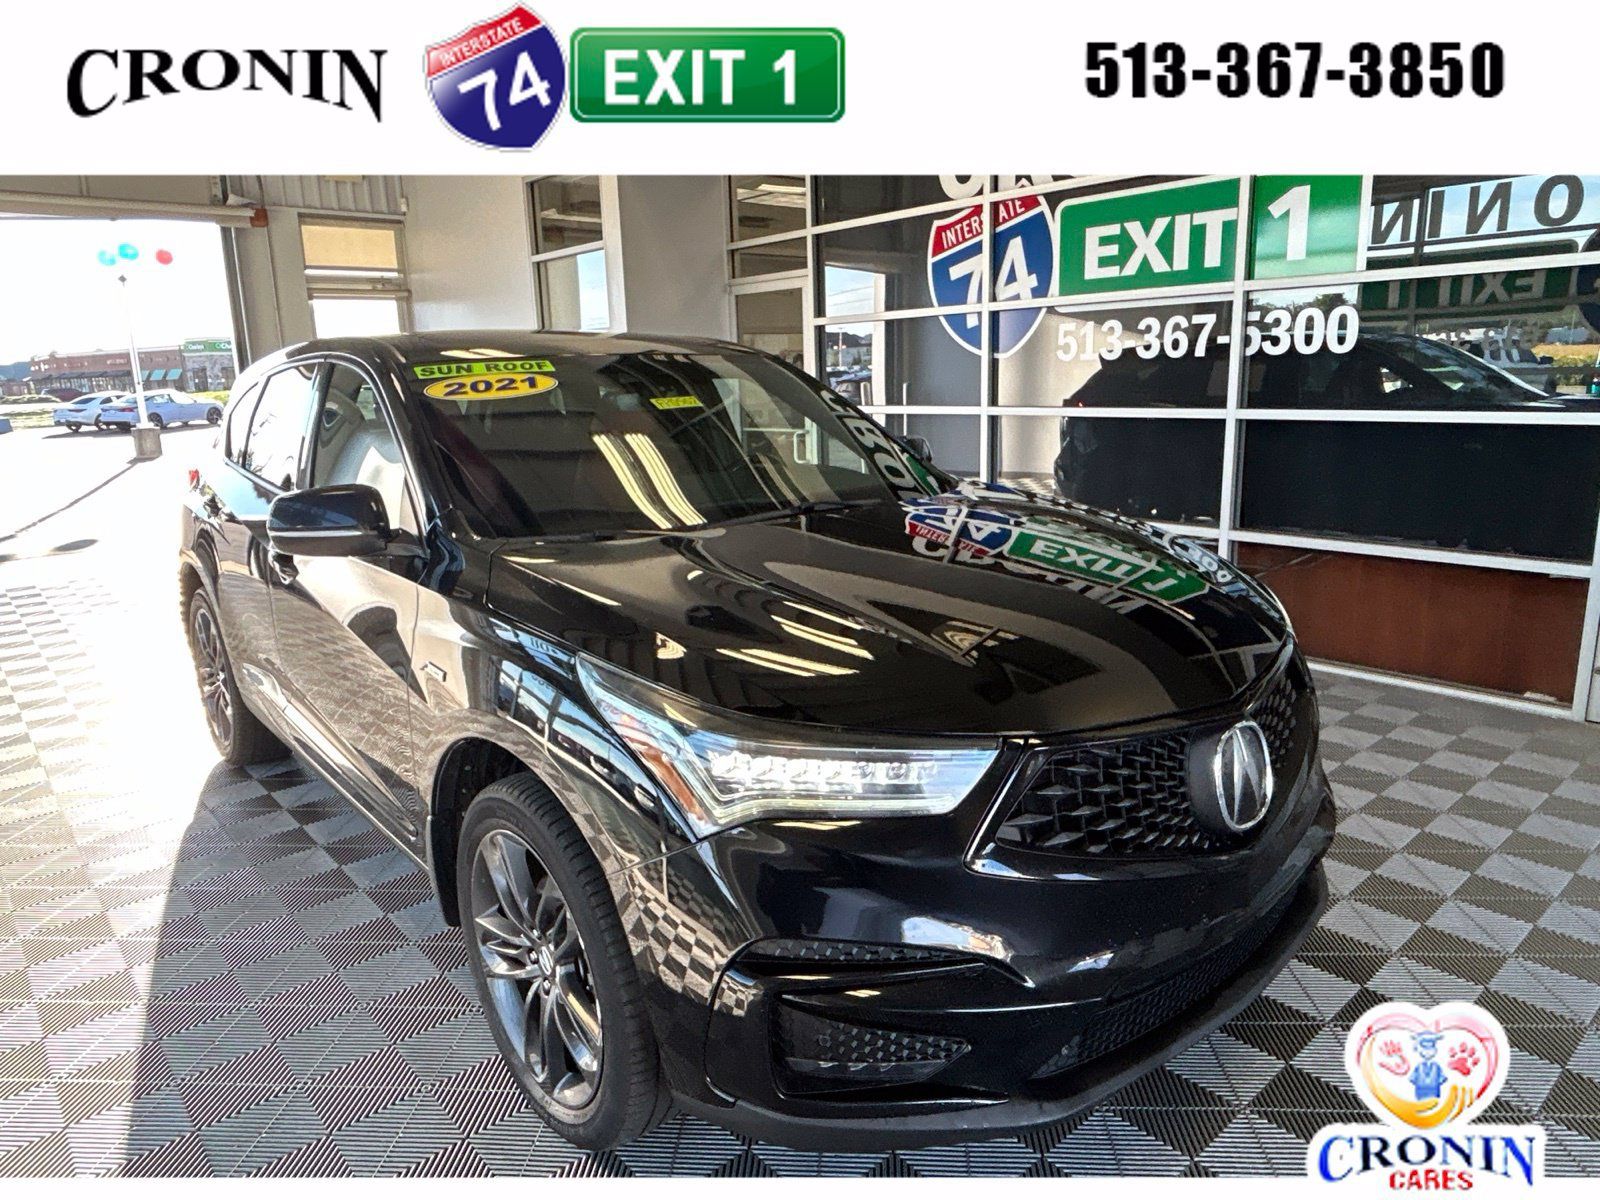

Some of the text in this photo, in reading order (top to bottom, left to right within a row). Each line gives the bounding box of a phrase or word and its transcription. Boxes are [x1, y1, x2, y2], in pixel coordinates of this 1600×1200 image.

[941, 199, 1025, 249] INTERATE
[1084, 185, 1311, 280] EXIT 1
[948, 235, 1038, 329] 74
[1055, 305, 1359, 361] 513-367-5300
[419, 360, 548, 377] SUN ROOF
[443, 376, 538, 397] 2021
